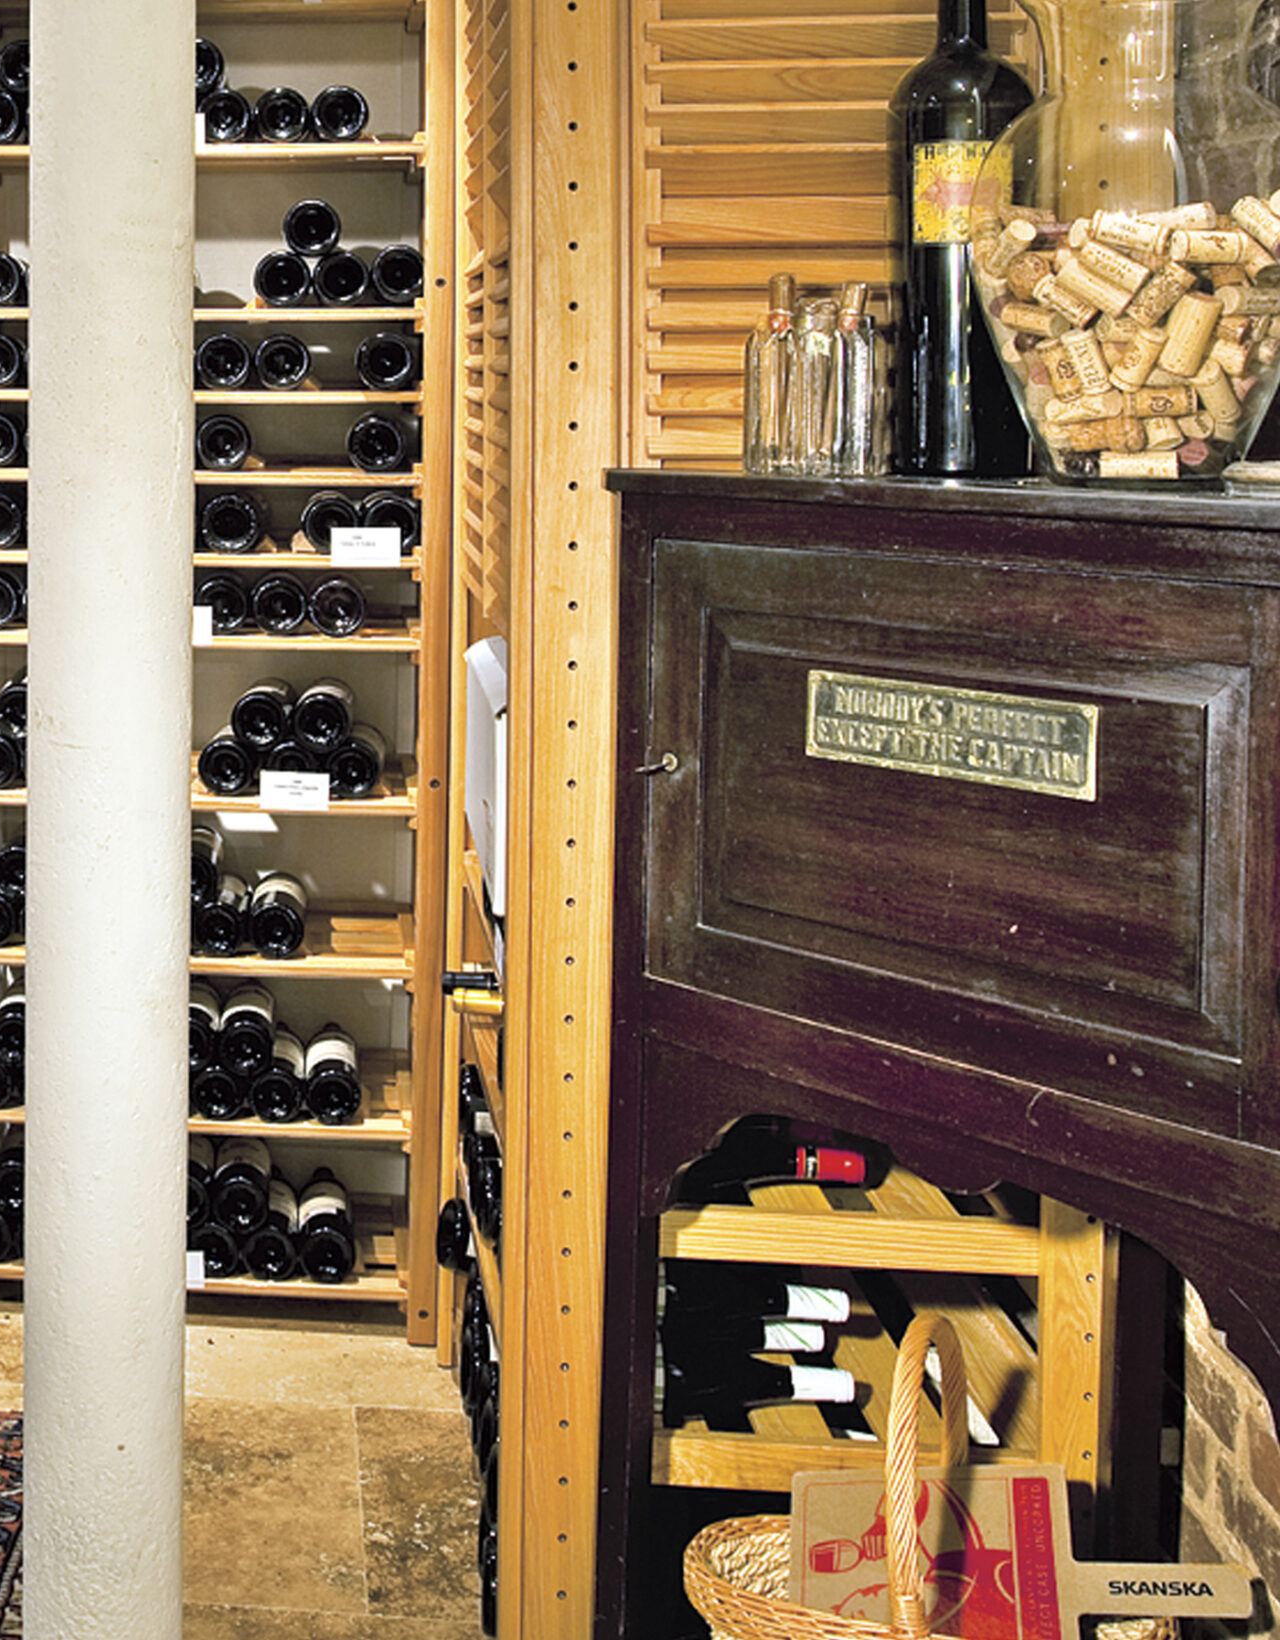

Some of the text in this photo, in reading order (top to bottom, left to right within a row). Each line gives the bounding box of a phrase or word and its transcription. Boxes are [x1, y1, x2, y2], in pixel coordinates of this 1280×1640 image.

[834, 685, 1068, 744] NOBODY'S PERFECT
[816, 717, 1082, 783] EXCEPT THE CAPTAIN
[1030, 1484, 1045, 1553] UNCORKED
[1108, 1580, 1214, 1598] SKANSKA
